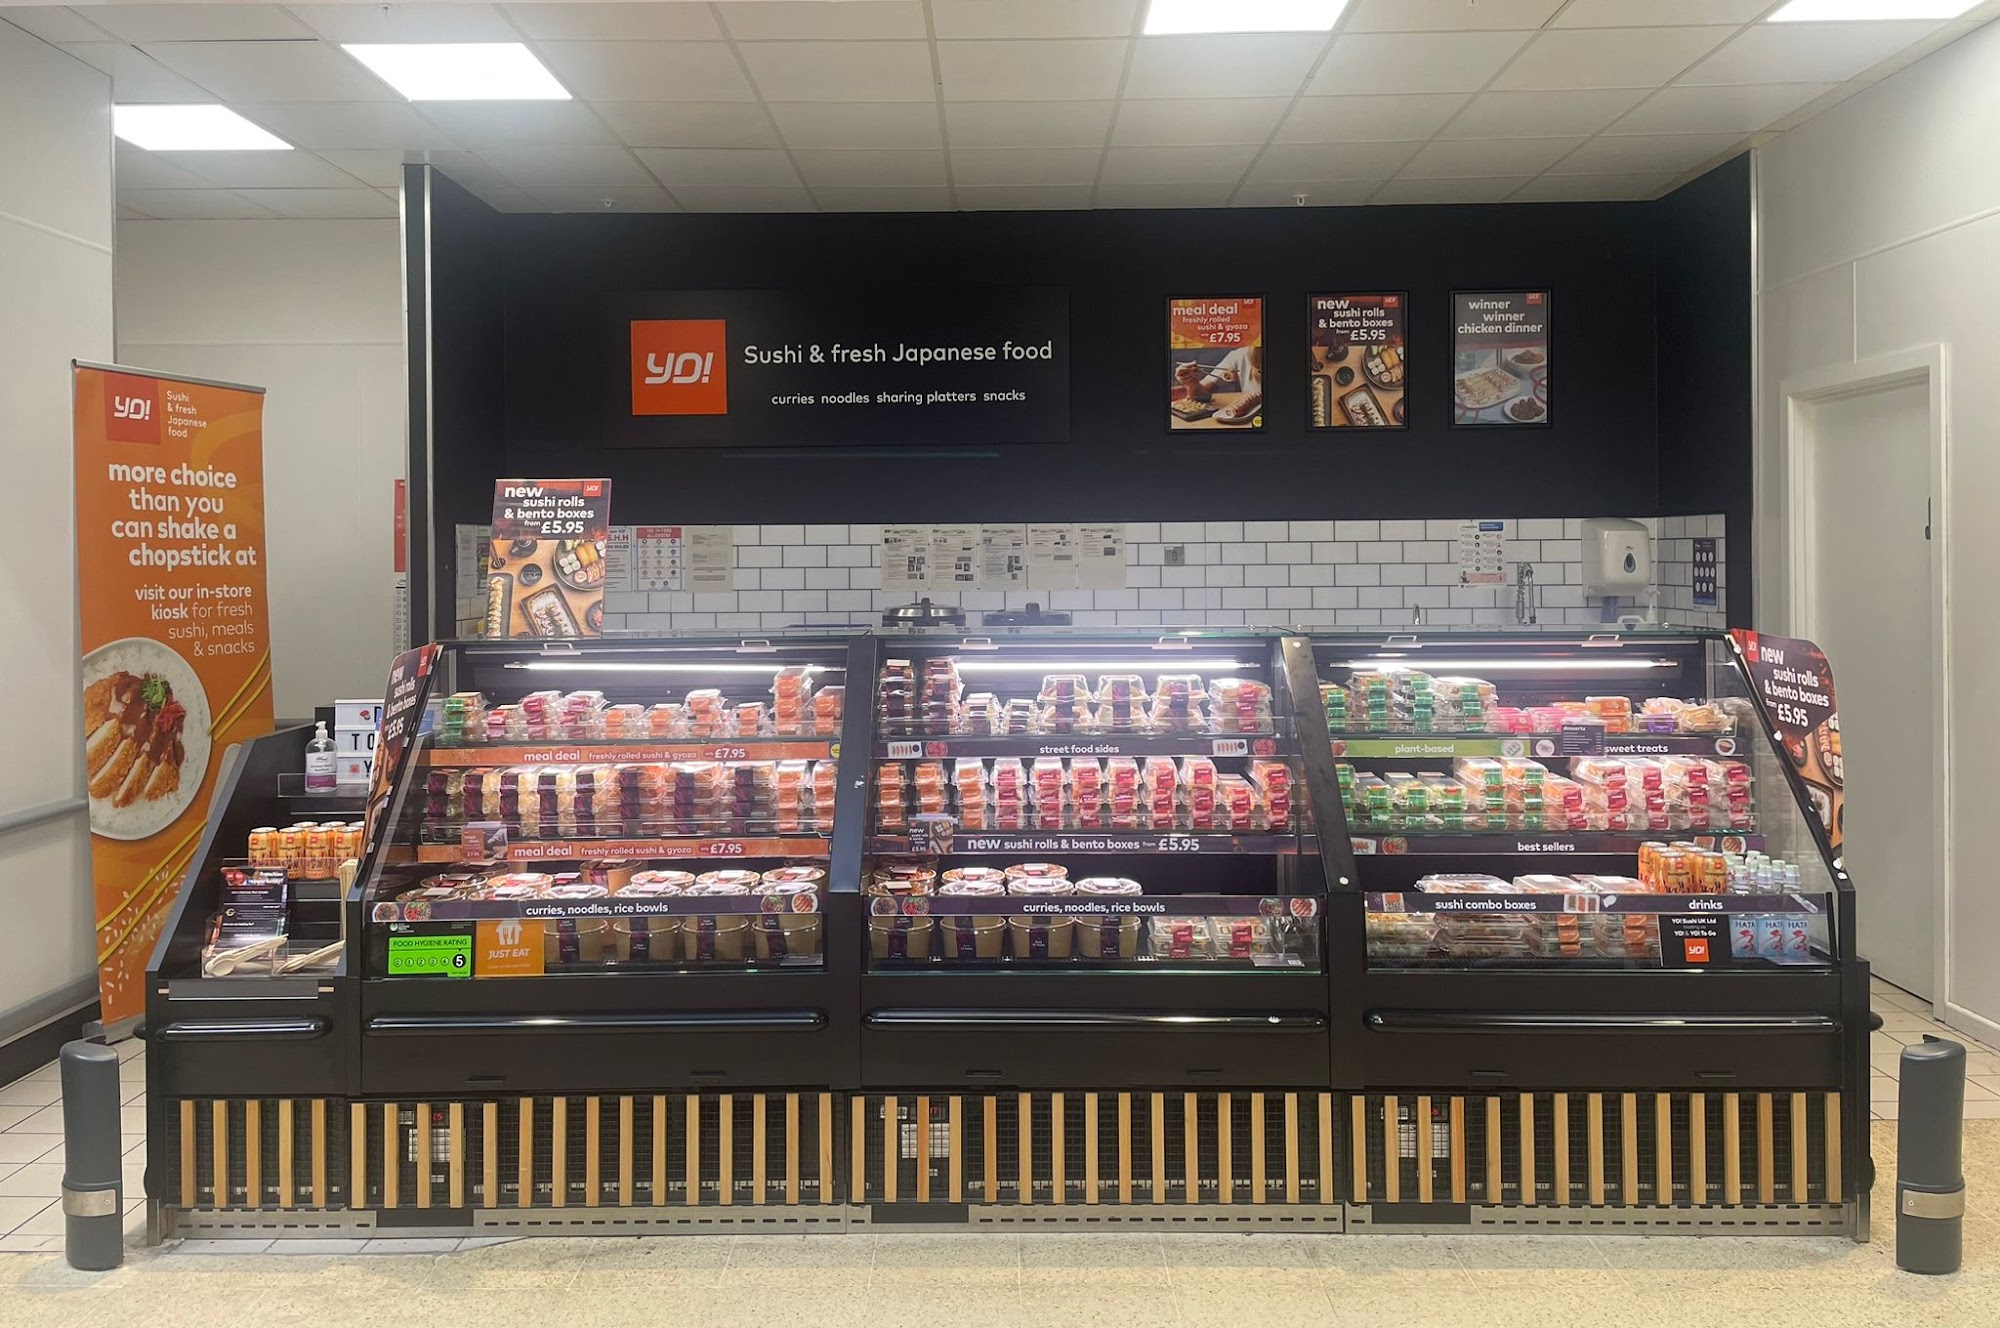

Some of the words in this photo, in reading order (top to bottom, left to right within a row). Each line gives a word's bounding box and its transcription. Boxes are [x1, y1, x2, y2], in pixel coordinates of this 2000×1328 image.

[1173, 303, 1206, 316] meal
[1209, 303, 1238, 314] deal
[1317, 299, 1350, 310] new
[1468, 298, 1511, 310] winner
[1333, 308, 1360, 318] sushi
[1362, 307, 1385, 317] rolls
[1483, 310, 1525, 321] winner
[1182, 316, 1207, 324] freshly
[1318, 318, 1327, 328] &
[1329, 318, 1360, 328] bento
[1362, 318, 1393, 327] boxes
[1197, 323, 1217, 331] sushi
[1458, 322, 1502, 334] chicken
[1504, 322, 1543, 333] dinner
[1209, 332, 1241, 343] £7.95
[1350, 329, 1386, 340] £5.95
[743, 344, 803, 365] Sushi
[809, 344, 825, 364] &
[831, 342, 886, 363] fresh
[892, 342, 997, 367] Japanese
[1002, 340, 1053, 362] food
[645, 351, 714, 385] YO!
[166, 390, 190, 402] Sushi
[771, 392, 815, 405] curries
[821, 391, 870, 405] noodles
[876, 390, 923, 408] sharing
[926, 389, 977, 406] platters
[983, 389, 1026, 402] snacks
[114, 395, 151, 420] YO!
[167, 404, 174, 412] &
[175, 404, 197, 415] fresh
[168, 416, 207, 429] Japanese
[168, 426, 188, 438] food
[108, 463, 166, 484] more
[170, 462, 237, 488] choice
[505, 486, 544, 498] new
[129, 488, 180, 512] than
[185, 494, 223, 518] you
[522, 496, 556, 507] sushi
[558, 496, 585, 507] rolls
[504, 508, 514, 519] &
[517, 508, 555, 518] bento
[557, 508, 594, 518] boxes
[111, 519, 152, 538] can
[158, 516, 219, 540] shake
[223, 523, 237, 540] a
[541, 521, 584, 534] £5.95
[129, 544, 231, 571] chopstick
[235, 546, 257, 566] at
[135, 583, 165, 601] visit
[168, 587, 193, 600] our
[196, 584, 252, 599] in-store
[151, 603, 189, 621] kiosk
[192, 603, 213, 618] for
[217, 602, 253, 617] fresh
[168, 624, 209, 639] sushi,
[212, 622, 254, 636] meals
[193, 642, 204, 657] &
[207, 639, 255, 656] snacks
[1761, 646, 1784, 665] new
[1773, 667, 1796, 684] sushi
[1797, 669, 1819, 688] rolls
[1764, 679, 1772, 694] &
[1772, 681, 1798, 701] bento
[1800, 686, 1829, 707] boxes
[1778, 704, 1808, 727] £5.95
[524, 750, 553, 761] meal
[555, 750, 580, 761] deal
[589, 752, 616, 761] freshly
[618, 751, 640, 760] rolled
[642, 751, 663, 759] sushi
[664, 751, 671, 759] &
[672, 752, 697, 760] gyoza
[714, 748, 745, 759] £7.95
[1040, 745, 1070, 754] street
[1071, 744, 1093, 754] food
[1095, 744, 1120, 754] sides
[1395, 744, 1454, 755] plant-based
[1604, 745, 1635, 753] sweet
[1637, 744, 1669, 753] treats
[514, 846, 543, 857] meal
[546, 846, 572, 856] deal
[581, 847, 608, 856] freshly
[610, 846, 634, 855] rolled
[636, 846, 658, 854] sushi
[659, 846, 666, 854] &
[667, 847, 691, 856] gyoza
[710, 843, 742, 854] £7.95
[967, 839, 1001, 849] new
[1004, 839, 1033, 849] sushi
[1035, 839, 1058, 849] rolls
[1060, 839, 1072, 849] &
[1072, 839, 1105, 849] bento
[1107, 839, 1140, 849] boxes
[1158, 838, 1200, 851] £5.95
[1517, 842, 1540, 852] best
[1542, 842, 1575, 852] sellers
[526, 904, 566, 916] curries,
[568, 903, 612, 915] noodles,
[614, 903, 634, 913] rice
[636, 902, 668, 913] bowls
[1023, 902, 1063, 913] curries,
[1064, 902, 1109, 913] noodles,
[1111, 902, 1132, 912] rice
[1134, 902, 1166, 912] bowls
[1435, 900, 1464, 910] sushi
[1465, 900, 1502, 910] combo
[1504, 900, 1537, 910] boxes
[1688, 900, 1723, 910] drinks
[443, 938, 467, 946] RATING
[488, 950, 510, 960] JUST
[512, 948, 531, 958] EAT
[1688, 946, 1705, 955] YO!
[456, 956, 463, 967] 5
